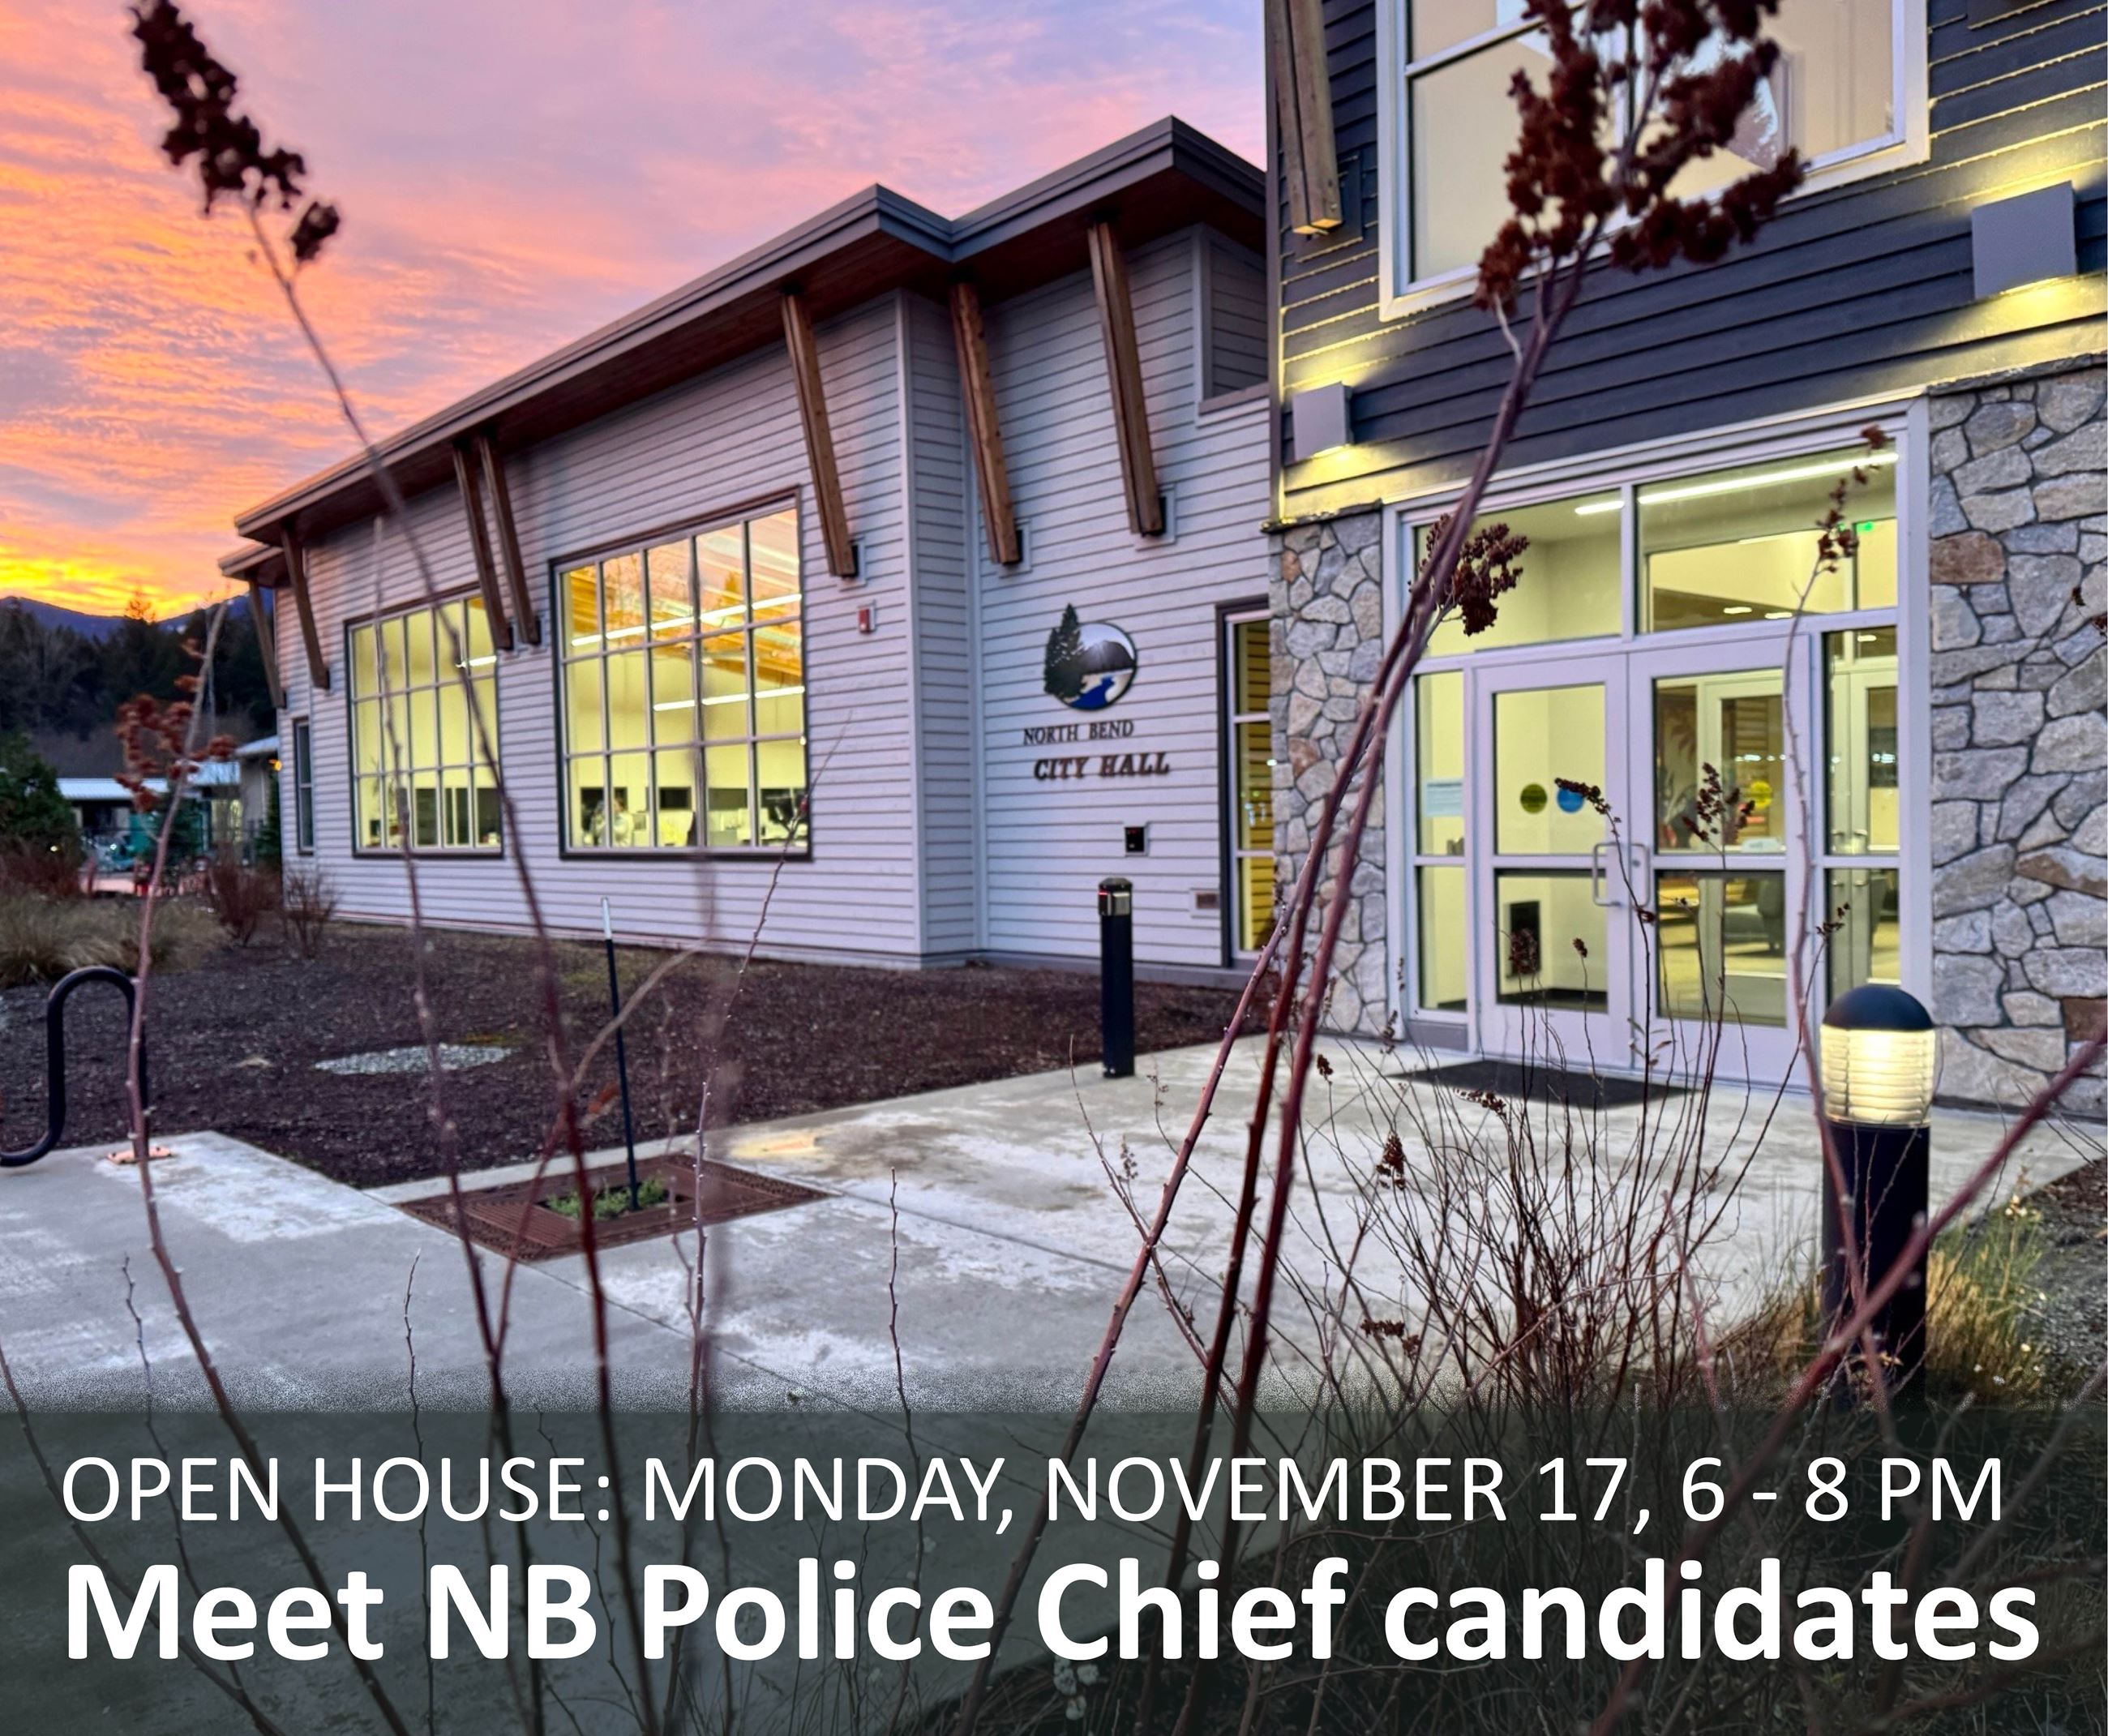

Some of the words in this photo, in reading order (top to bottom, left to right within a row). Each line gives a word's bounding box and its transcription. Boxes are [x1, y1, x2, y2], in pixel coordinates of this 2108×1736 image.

[1023, 724, 1078, 745] NORTH
[1088, 719, 1134, 739] BEND
[1034, 757, 1090, 780] CITY
[1098, 752, 1170, 777] HALL
